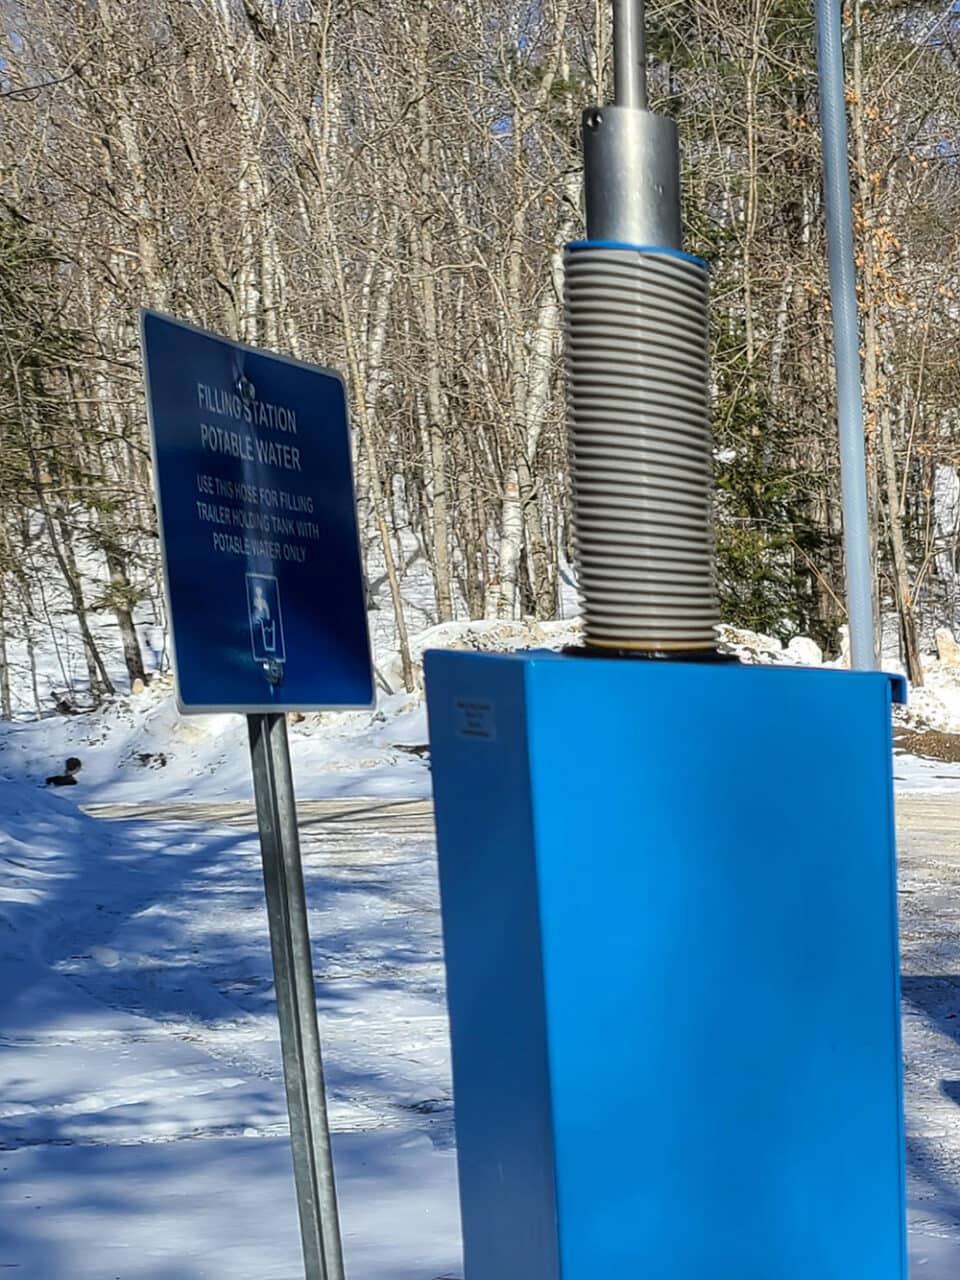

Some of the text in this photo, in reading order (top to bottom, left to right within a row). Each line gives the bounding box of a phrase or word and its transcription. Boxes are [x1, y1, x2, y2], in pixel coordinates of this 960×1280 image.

[197, 382, 297, 435] FILLING STATION
[200, 423, 301, 472] POTABLE WATER
[197, 474, 314, 514] USE THIS HOSE FOR FILLING
[196, 501, 320, 539] TRAILER HOLDING TANK WITH
[213, 532, 306, 563] POTABLE WATER ONLY
